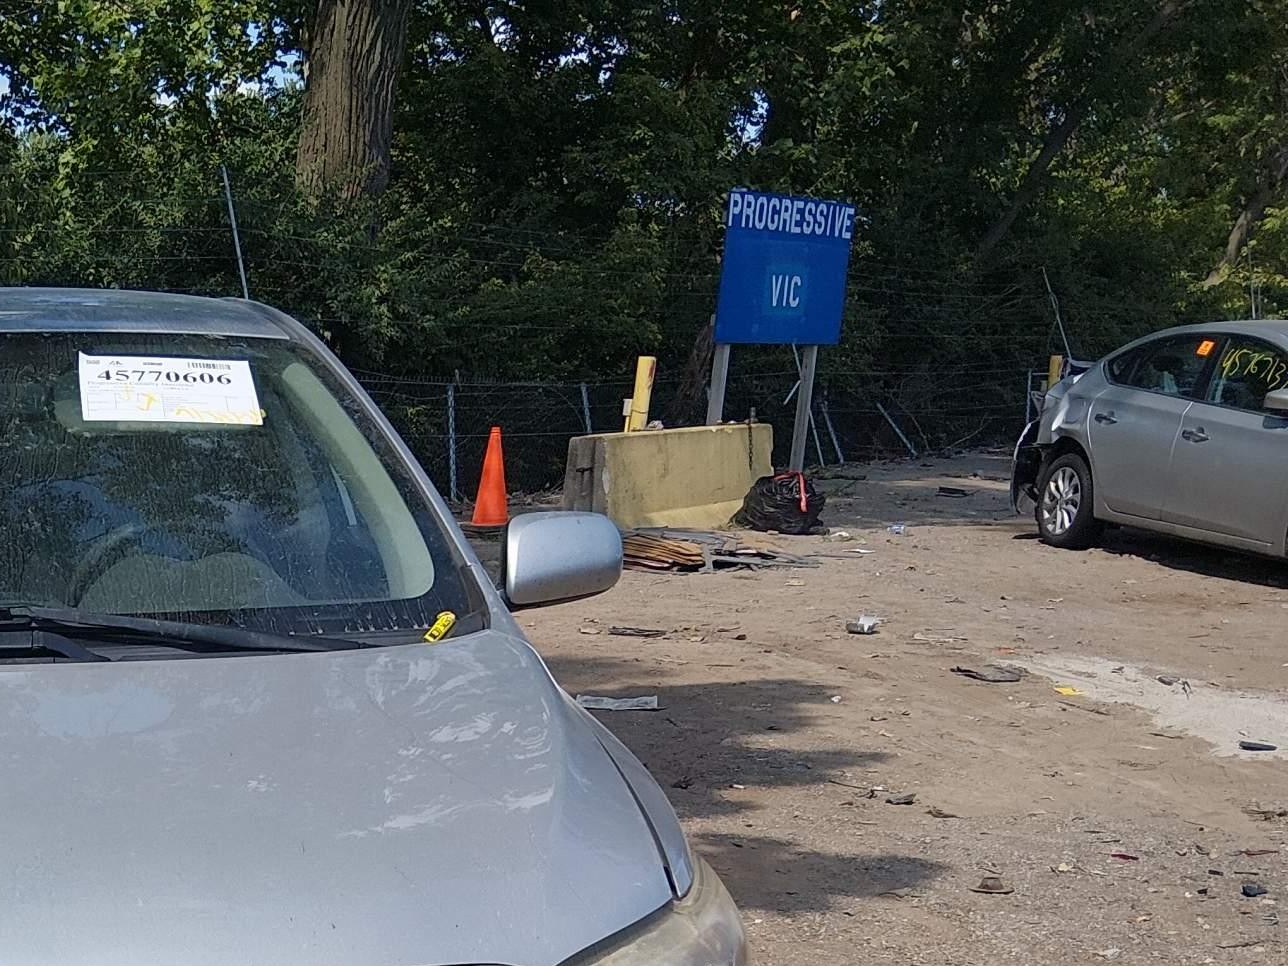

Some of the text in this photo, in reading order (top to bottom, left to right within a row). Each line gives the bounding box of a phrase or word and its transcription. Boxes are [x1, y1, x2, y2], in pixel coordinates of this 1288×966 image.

[728, 193, 855, 239] PROGRESSIVE
[772, 275, 801, 307] VIC
[97, 369, 232, 385] 45770606
[1219, 345, 1288, 390] 4576713
